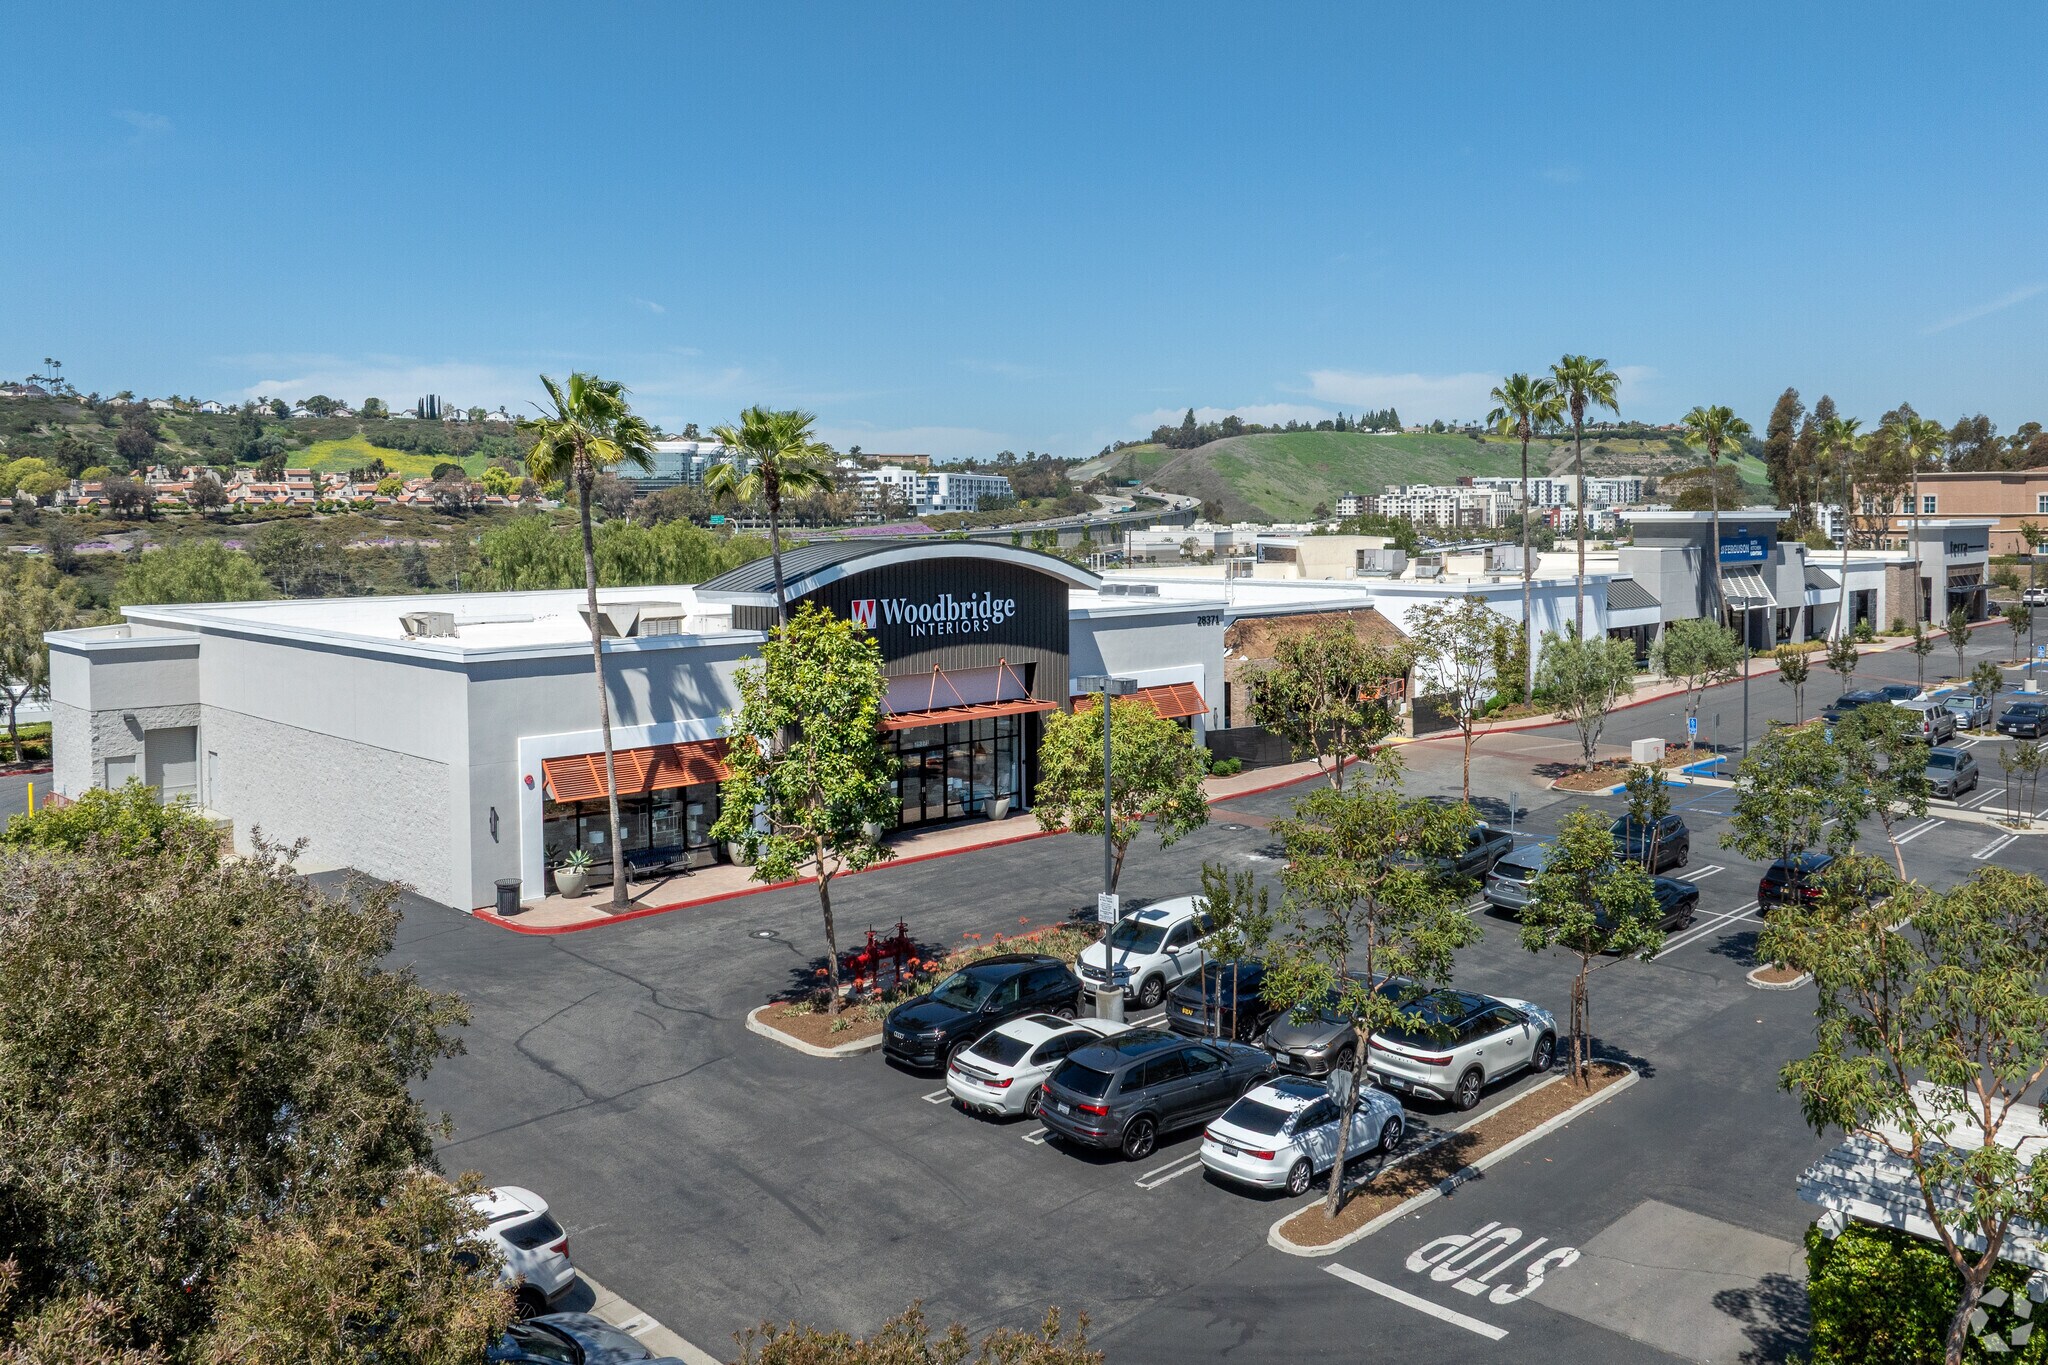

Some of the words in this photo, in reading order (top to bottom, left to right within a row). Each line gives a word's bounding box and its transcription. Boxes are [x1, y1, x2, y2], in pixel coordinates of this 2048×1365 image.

[1725, 544, 1749, 554] FERGUSON
[881, 591, 1015, 625] Woodbridge
[910, 619, 989, 637] INTERIORS
[1197, 615, 1220, 626] 28371
[1406, 1221, 1581, 1305] STOP
